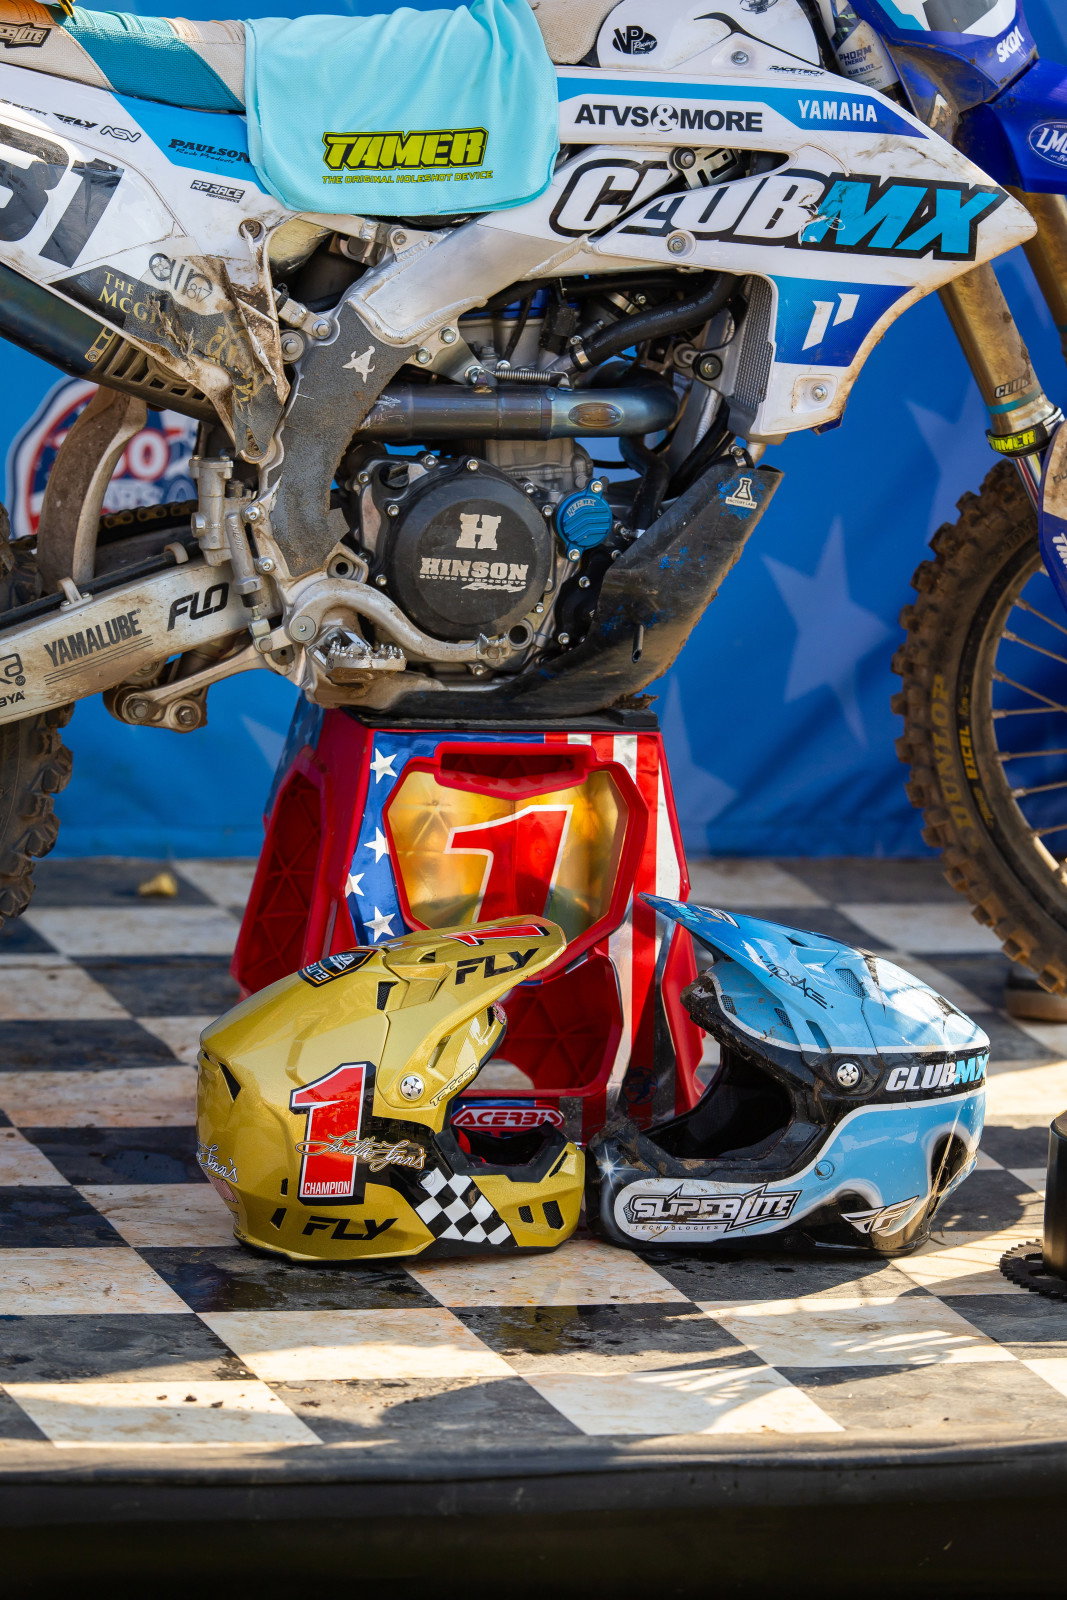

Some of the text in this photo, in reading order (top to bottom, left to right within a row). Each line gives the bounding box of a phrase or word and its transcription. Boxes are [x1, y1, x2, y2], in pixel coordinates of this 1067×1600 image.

[613, 25, 643, 54] VP
[575, 104, 763, 132] ATVS&MORE
[798, 100, 878, 123] YAMAHA
[168, 139, 250, 163] PAULSON
[322, 127, 489, 171] TAMER
[1036, 127, 1067, 154] LM
[209, 184, 244, 198] RACE
[322, 171, 494, 184] THE ORIGINAL HOLESHOT DEVICE
[549, 158, 1010, 262] CLUBMX
[104, 271, 136, 296] THE
[456, 513, 501, 550] H
[419, 557, 529, 580] HINSON
[167, 582, 230, 632] FLO
[930, 674, 976, 829] DUNLOP
[959, 725, 979, 780] EXCEL
[443, 804, 574, 924] 1
[455, 947, 540, 985] FLY
[886, 1053, 989, 1092] CLUBMX
[290, 1061, 376, 1206] 1
[304, 1181, 350, 1195] CHAMPION
[301, 1215, 399, 1241] FLY
